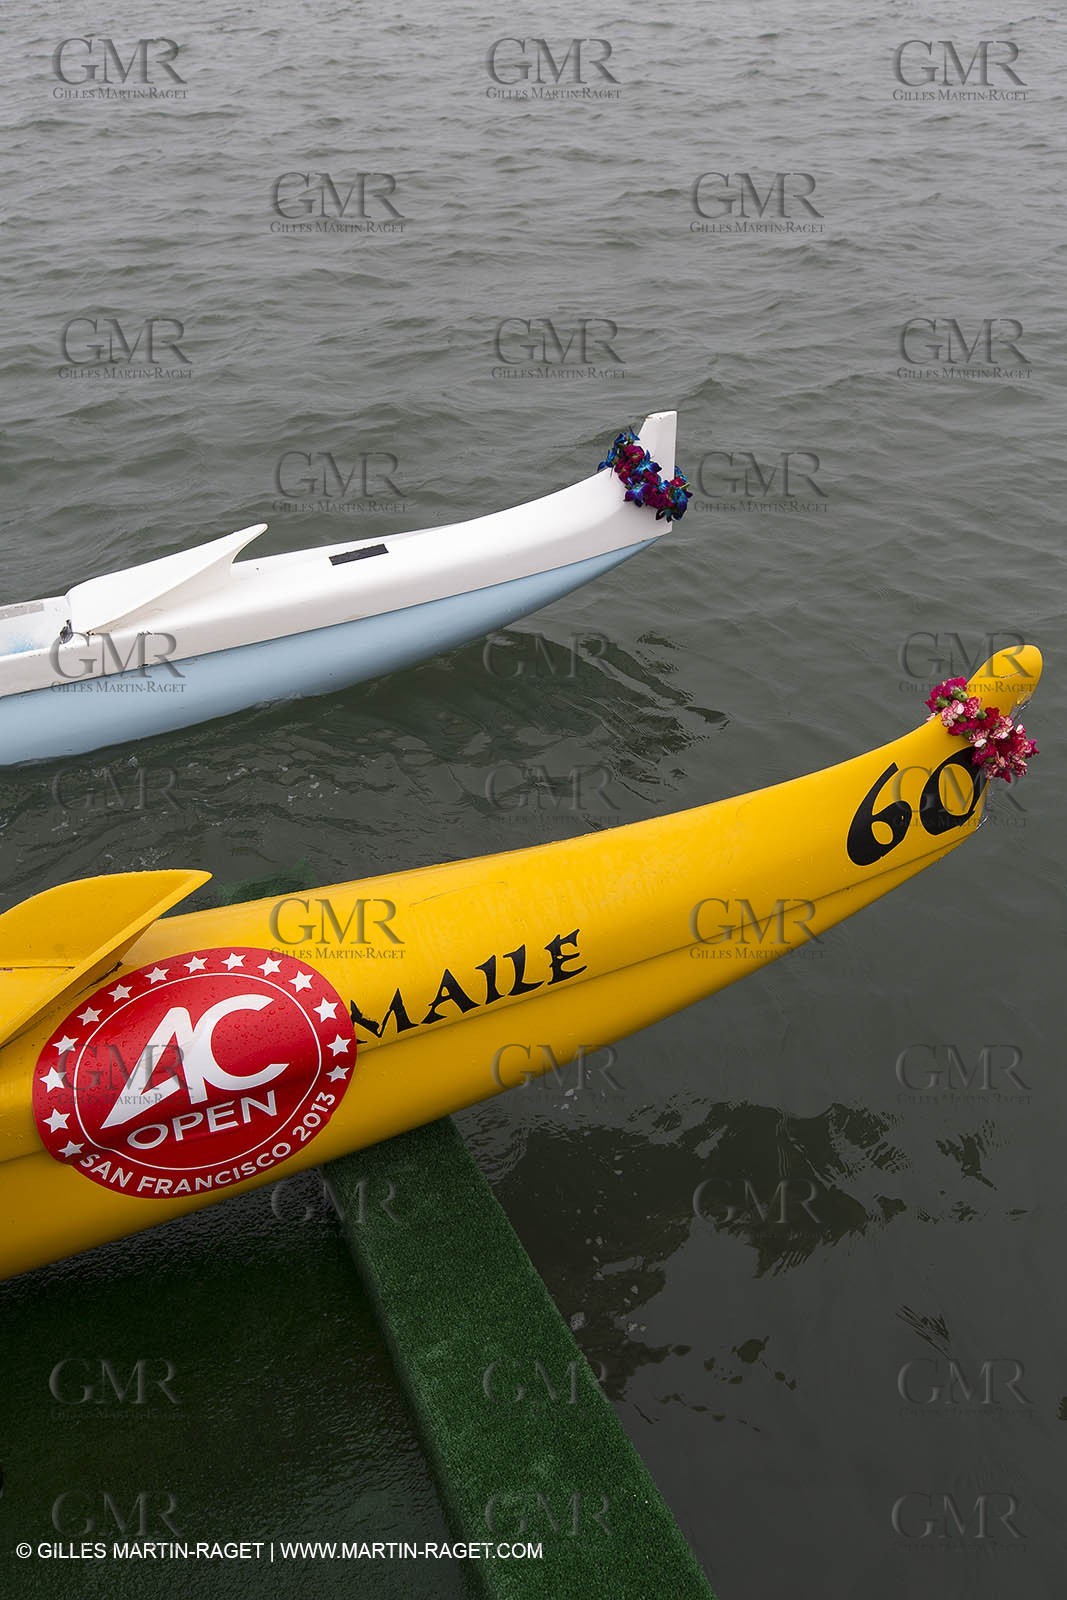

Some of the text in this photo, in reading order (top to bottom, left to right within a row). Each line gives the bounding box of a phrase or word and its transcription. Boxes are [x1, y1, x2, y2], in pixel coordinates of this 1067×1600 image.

[847, 745, 988, 866] 60
[100, 994, 289, 1129] AC
[79, 1091, 336, 1195] SAN FRANCISCO 2013
[126, 1090, 278, 1150] OPEN
